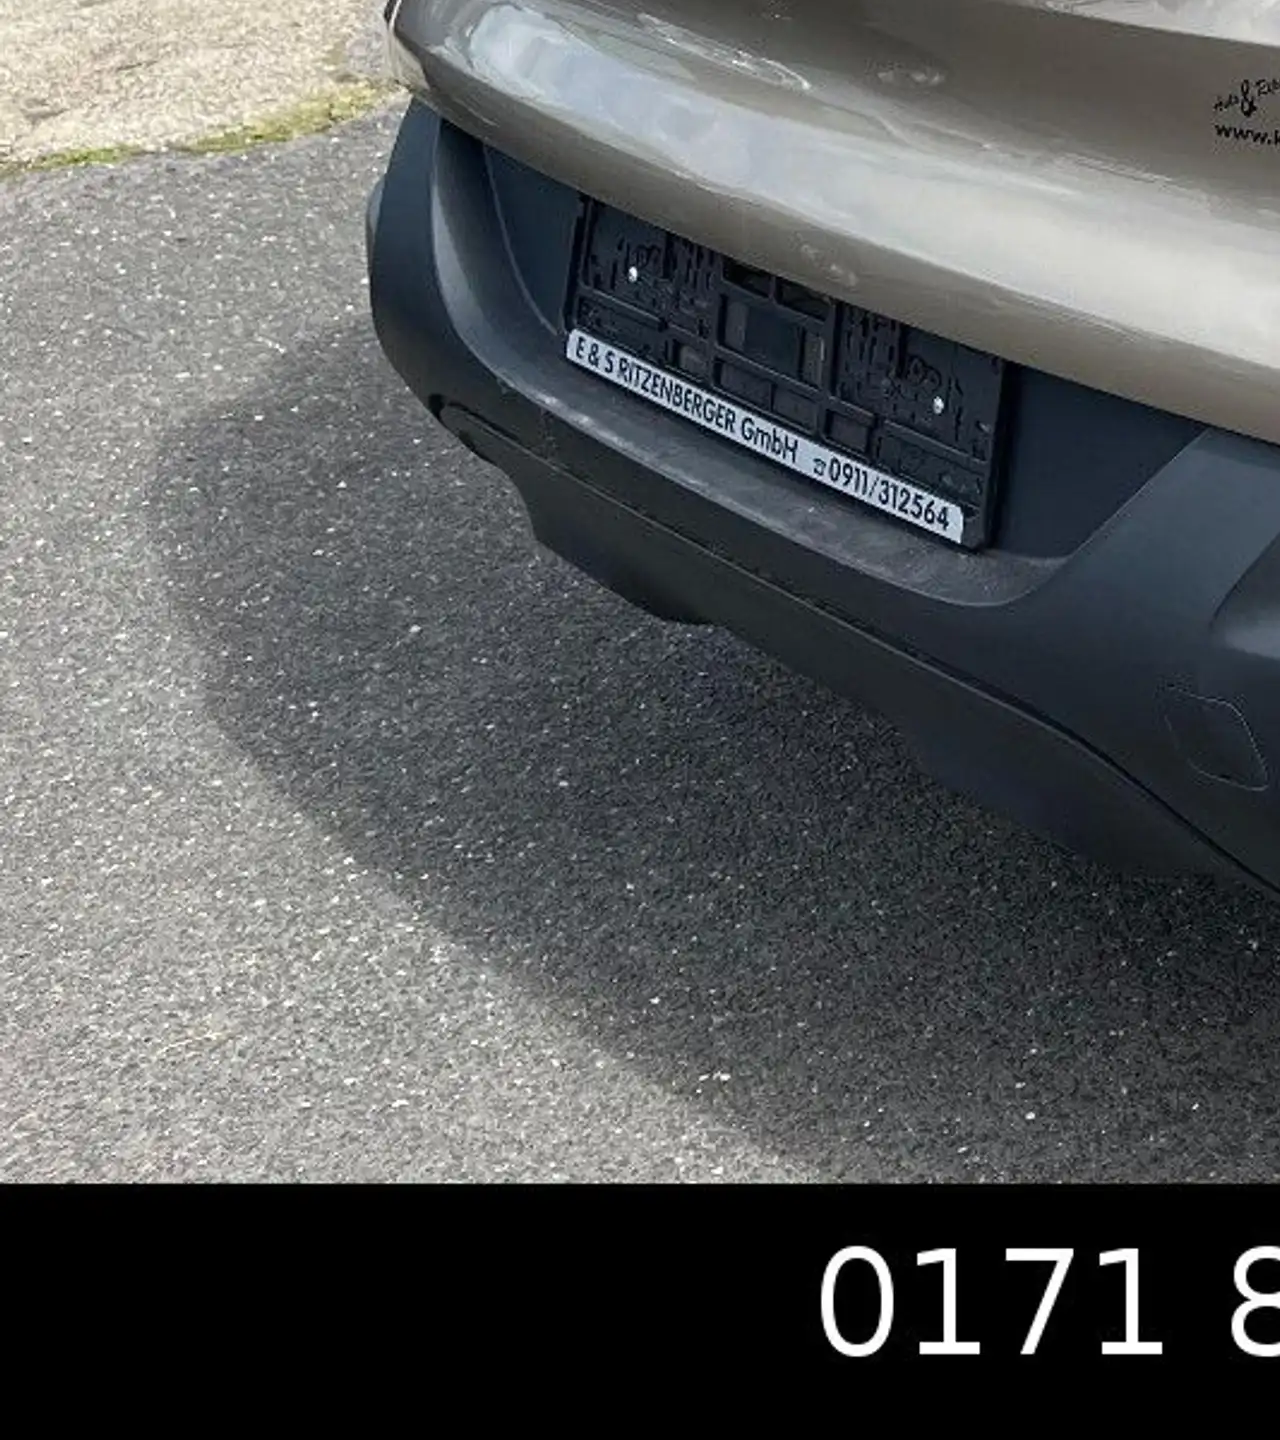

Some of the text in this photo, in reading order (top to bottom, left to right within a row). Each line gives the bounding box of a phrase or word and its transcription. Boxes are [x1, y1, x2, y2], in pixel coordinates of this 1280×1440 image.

[575, 336, 950, 531] E & S RITZENBERGER GmbH 0911/312564
